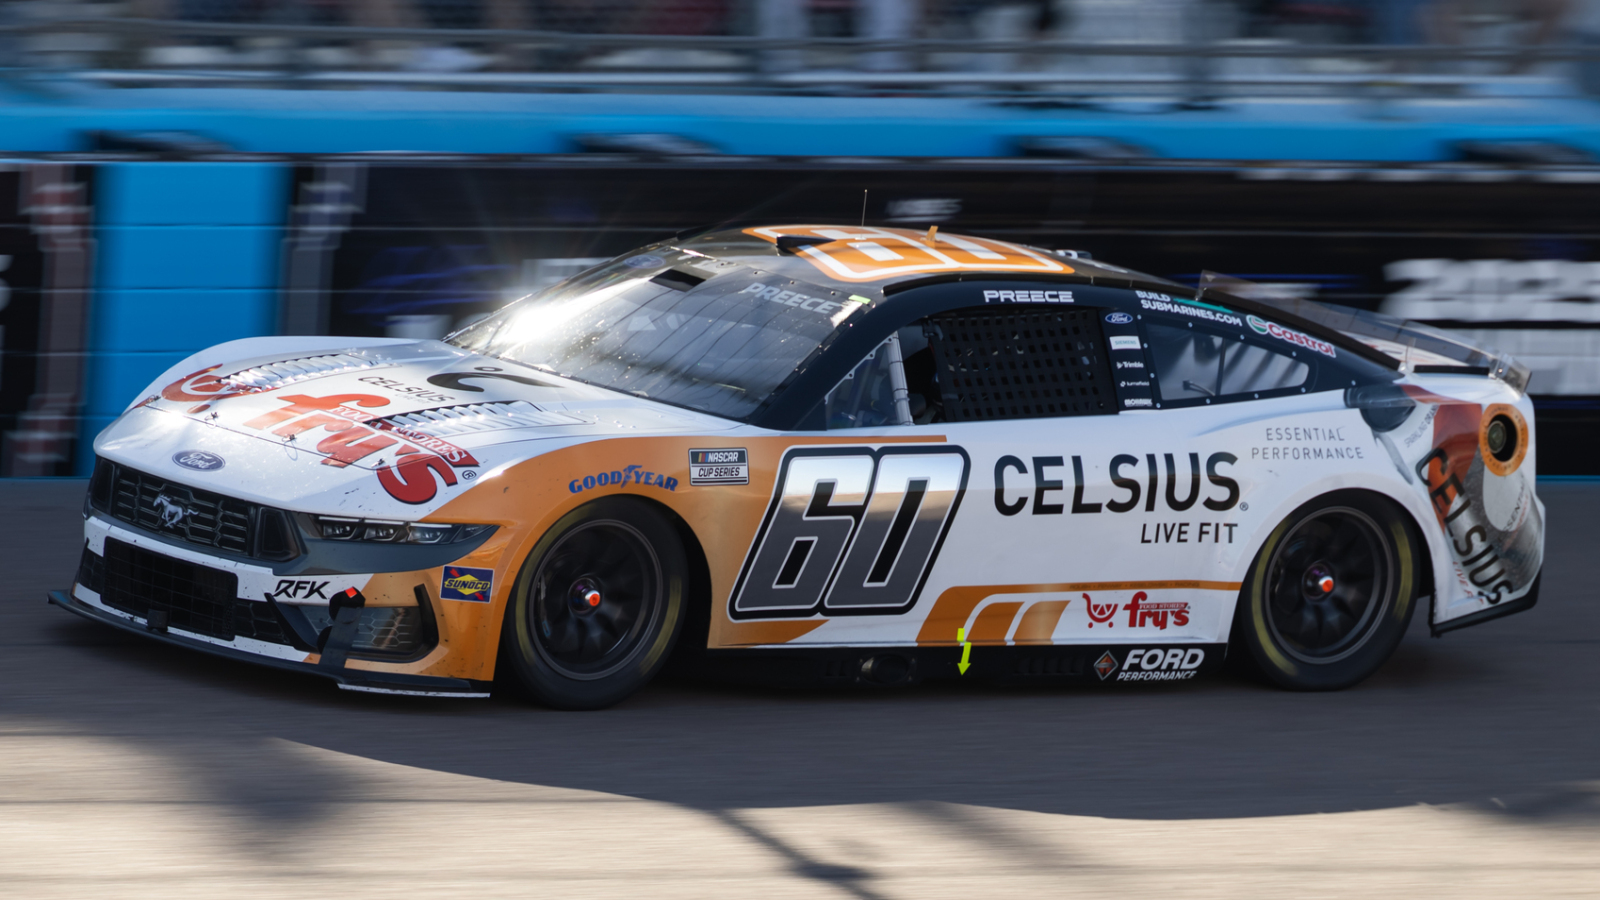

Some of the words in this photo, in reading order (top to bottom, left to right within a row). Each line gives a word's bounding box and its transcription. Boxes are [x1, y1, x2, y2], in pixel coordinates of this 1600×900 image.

[738, 282, 842, 315] PREECE
[983, 290, 1074, 303] PREECE
[1135, 290, 1171, 302] BUILD
[1108, 312, 1129, 323] Ford
[1140, 300, 1243, 327] SUBMARINES.COM
[1267, 322, 1336, 357] Castrol
[358, 376, 456, 402] CELSIUS
[1266, 427, 1345, 441] ESSENTIAL
[707, 451, 739, 463] NASCAR
[1251, 447, 1364, 460] PERFORMANCE
[698, 467, 713, 478] CUP
[713, 466, 741, 477] SERIES
[994, 451, 1240, 516] CELSIUS
[727, 445, 971, 622] 60
[1141, 522, 1190, 544] LIVE
[1198, 522, 1239, 544] FIT
[1415, 447, 1513, 605] CELSIUS
[273, 579, 331, 599] RFK
[444, 578, 491, 592] SUNOCO
[1122, 591, 1190, 630] fry's
[1121, 649, 1205, 670] FORD
[1116, 671, 1197, 682] PERFORMANCE
